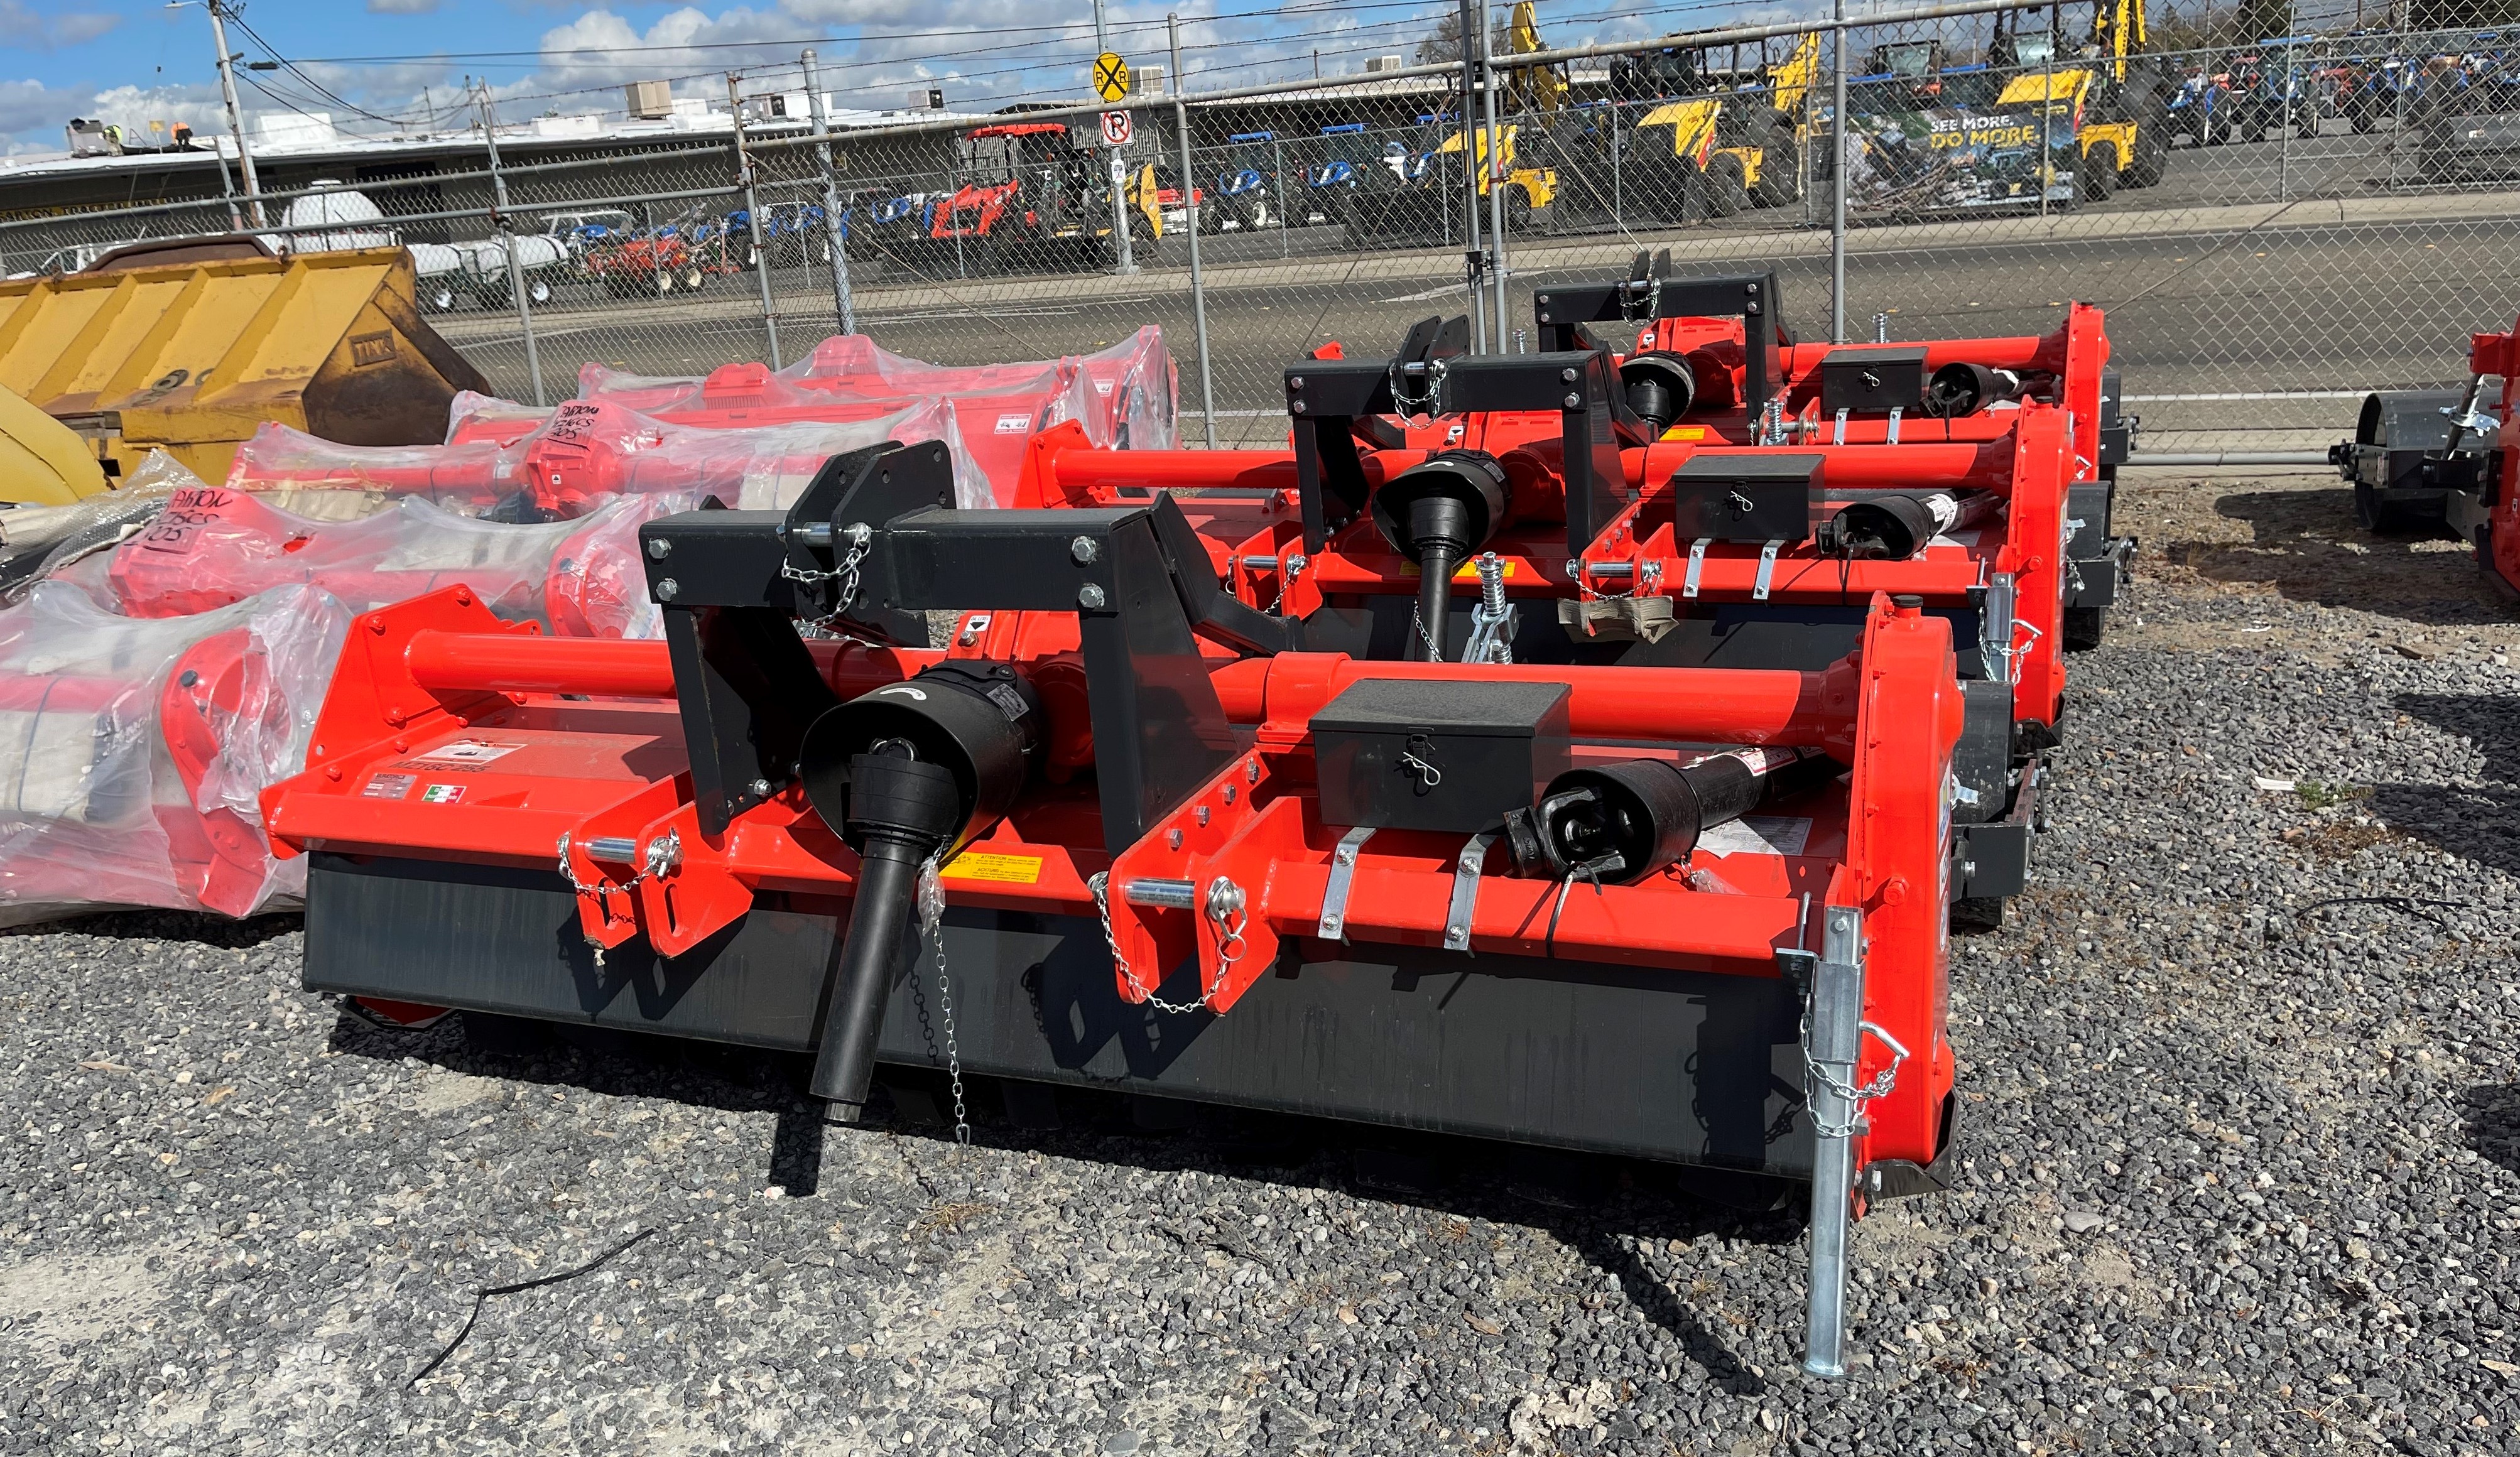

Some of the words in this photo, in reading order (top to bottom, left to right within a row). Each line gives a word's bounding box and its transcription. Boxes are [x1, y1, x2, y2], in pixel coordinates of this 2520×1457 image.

[1095, 72, 1104, 84] R
[1119, 71, 1127, 83] R
[1931, 119, 1958, 132] SEE
[1962, 115, 2014, 130] MORE.
[1930, 132, 1964, 148] DO
[1969, 125, 2041, 146] MORE.
